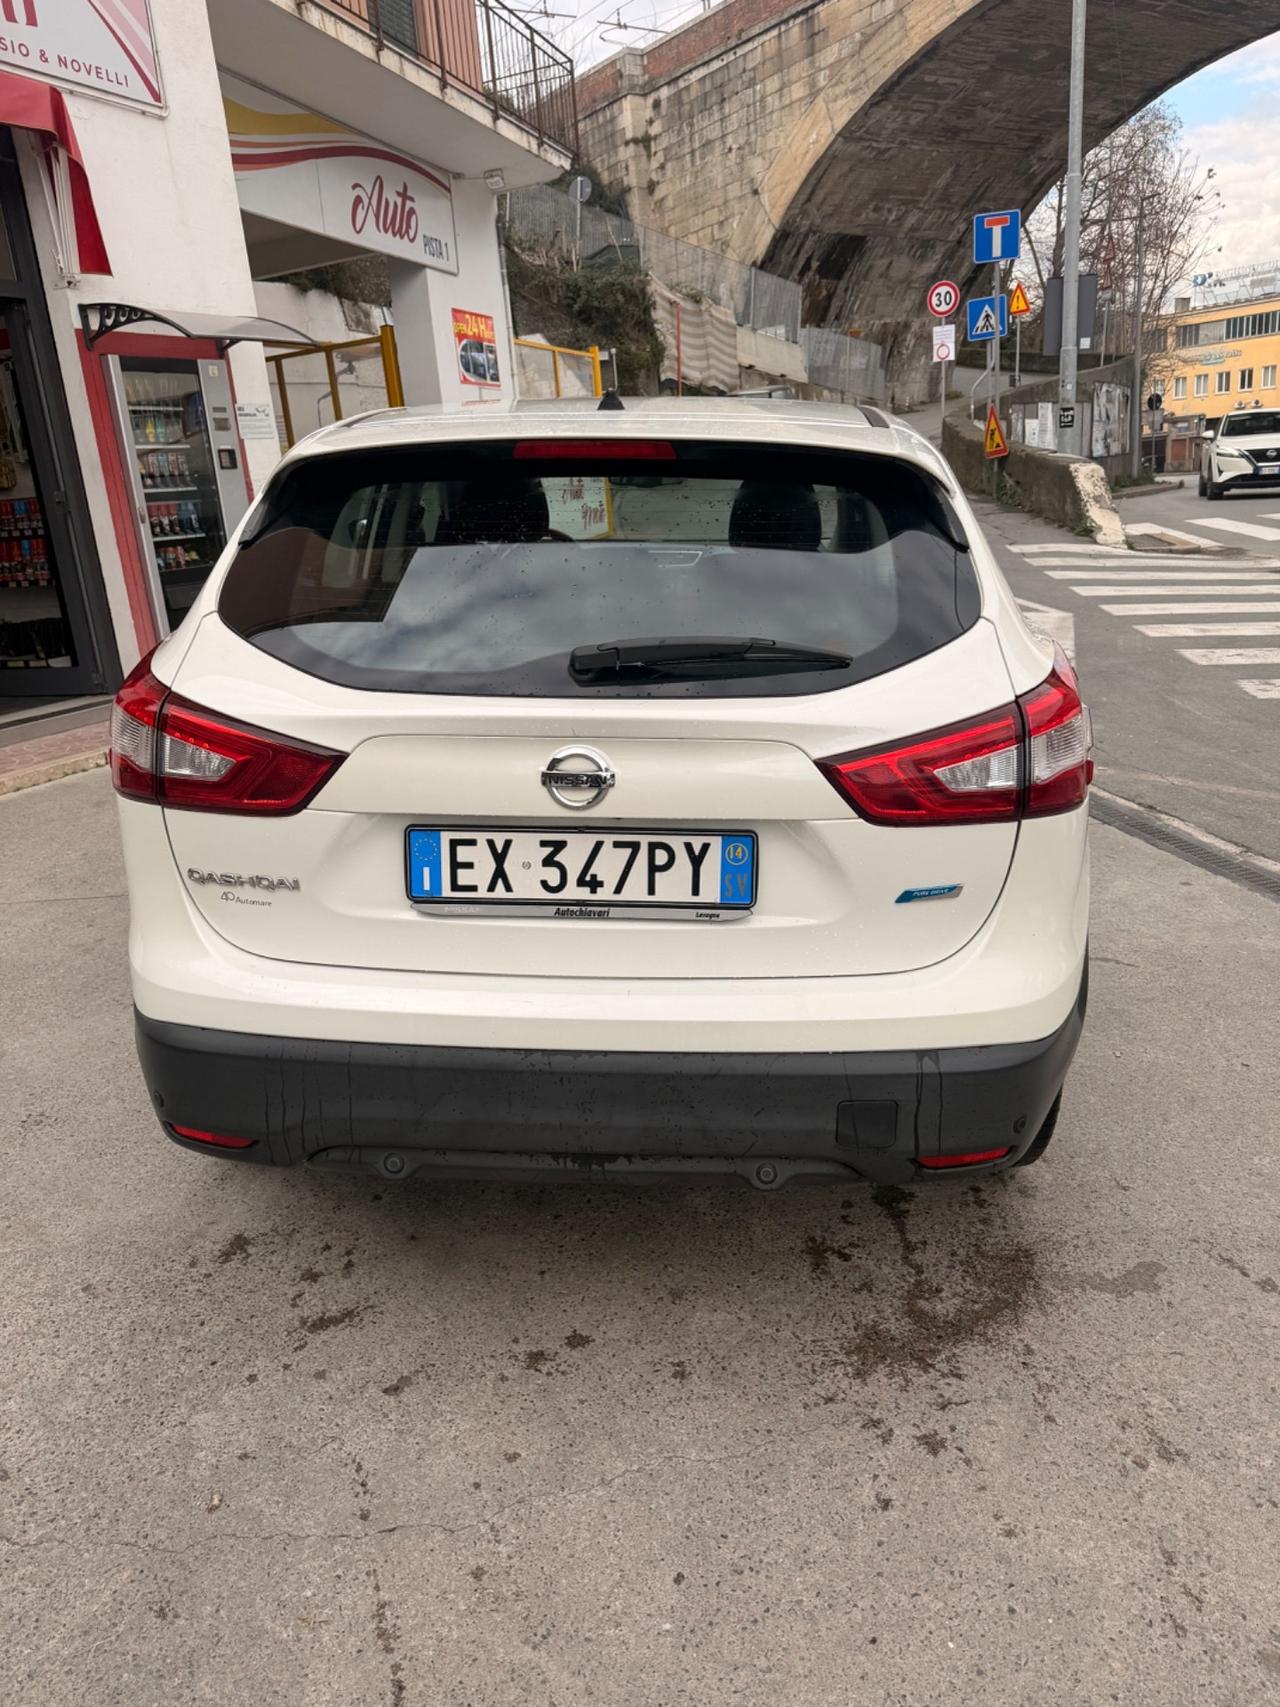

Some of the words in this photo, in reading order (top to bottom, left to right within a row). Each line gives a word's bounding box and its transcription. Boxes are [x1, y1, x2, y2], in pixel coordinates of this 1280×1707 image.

[39, 48, 49, 63] &
[57, 54, 130, 88] NOVELLI
[351, 175, 419, 244] Auto
[423, 234, 444, 260] PISTA
[443, 242, 450, 262] 1
[935, 290, 953, 308] 30
[548, 774, 608, 786] NISSAN
[729, 845, 743, 860] 14
[187, 867, 300, 892] QASHQAI
[449, 838, 514, 893] EX
[539, 839, 712, 897] 347PY
[724, 872, 748, 898] SV
[554, 907, 611, 918] Autochiavari
